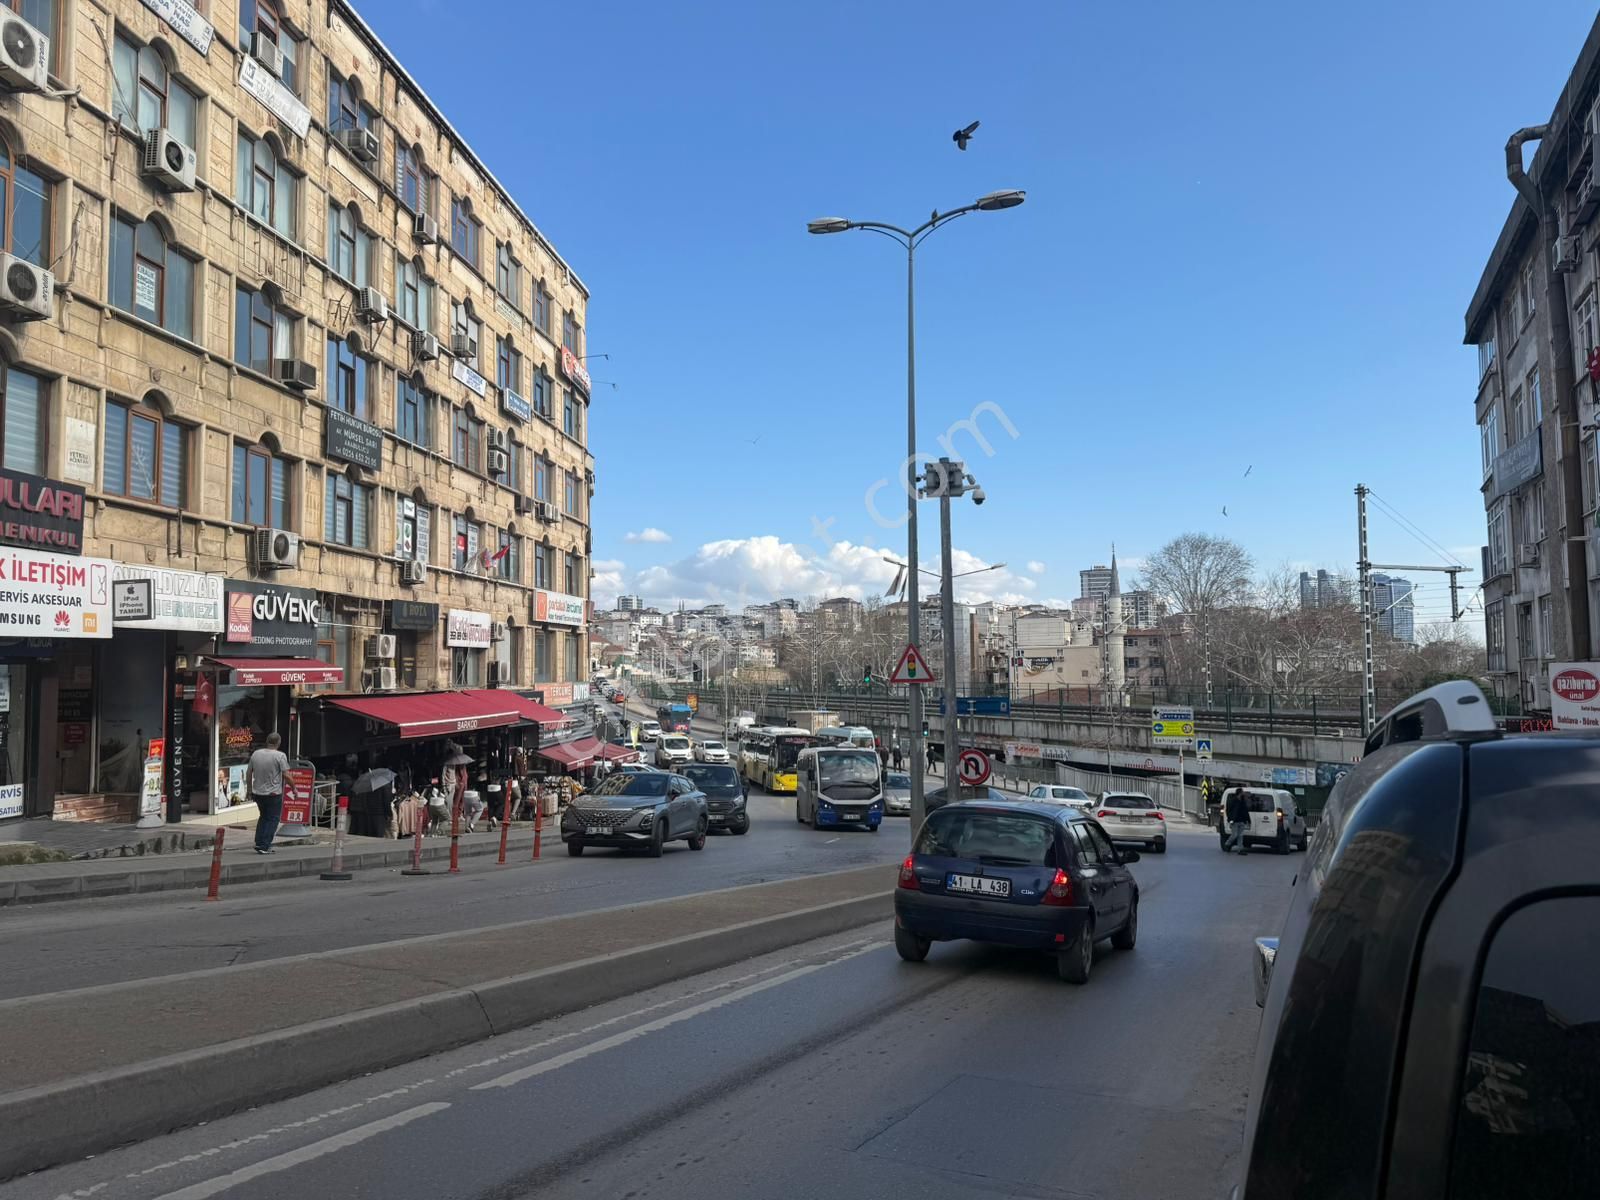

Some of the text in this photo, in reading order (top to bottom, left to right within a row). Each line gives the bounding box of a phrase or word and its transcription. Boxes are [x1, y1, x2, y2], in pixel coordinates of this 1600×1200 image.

[12, 553, 86, 590] İLETİŞİM
[31, 593, 82, 607] AKSESUAR
[253, 589, 319, 628] GÜVENÇ
[229, 623, 250, 633] Kodak
[275, 637, 313, 646] PHOTOGRAPHY
[281, 672, 306, 683] GÜVENÇ
[1557, 676, 1596, 692] gaziburma
[970, 879, 982, 890] LA
[990, 880, 1008, 893] 438
